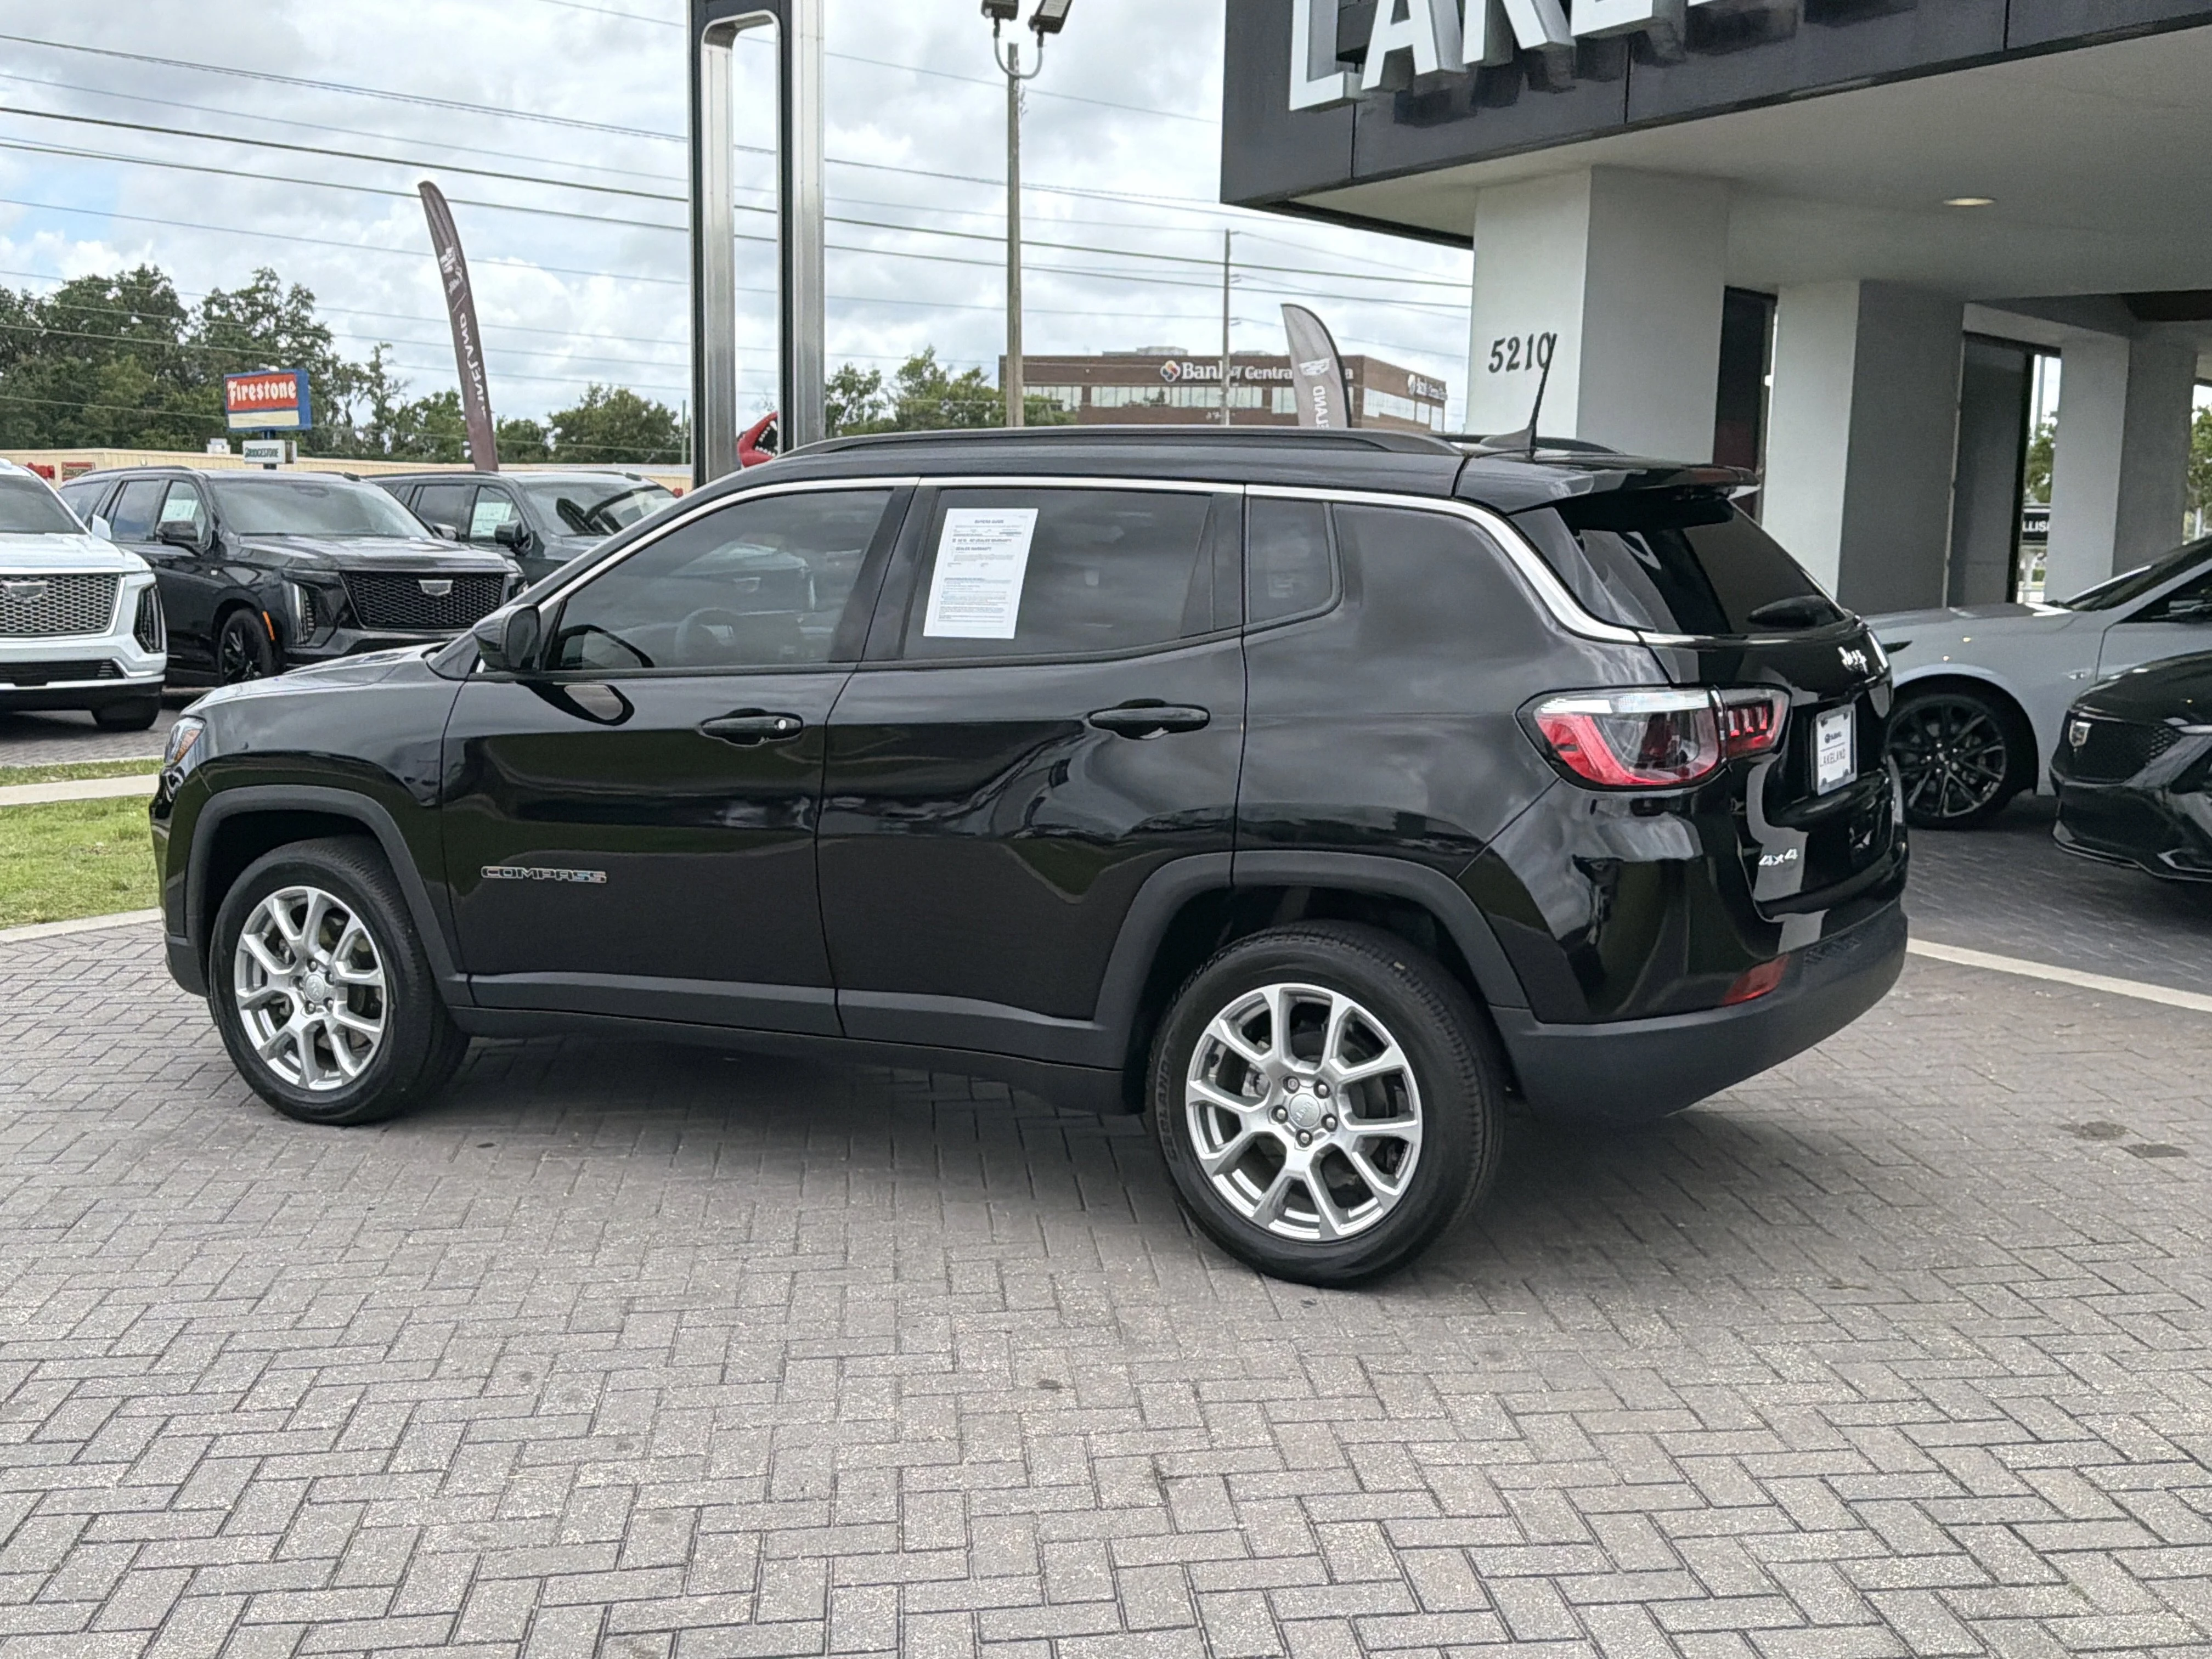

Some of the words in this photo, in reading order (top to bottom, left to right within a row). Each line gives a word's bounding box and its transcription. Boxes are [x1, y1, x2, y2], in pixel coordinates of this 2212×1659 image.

[1289, 0, 1713, 111] LAK
[1488, 331, 1552, 373] 5210
[1245, 365, 1293, 380] Centra
[227, 380, 297, 406] Firestone
[1758, 848, 1798, 866] 4x4
[481, 866, 607, 884] COMPASS
